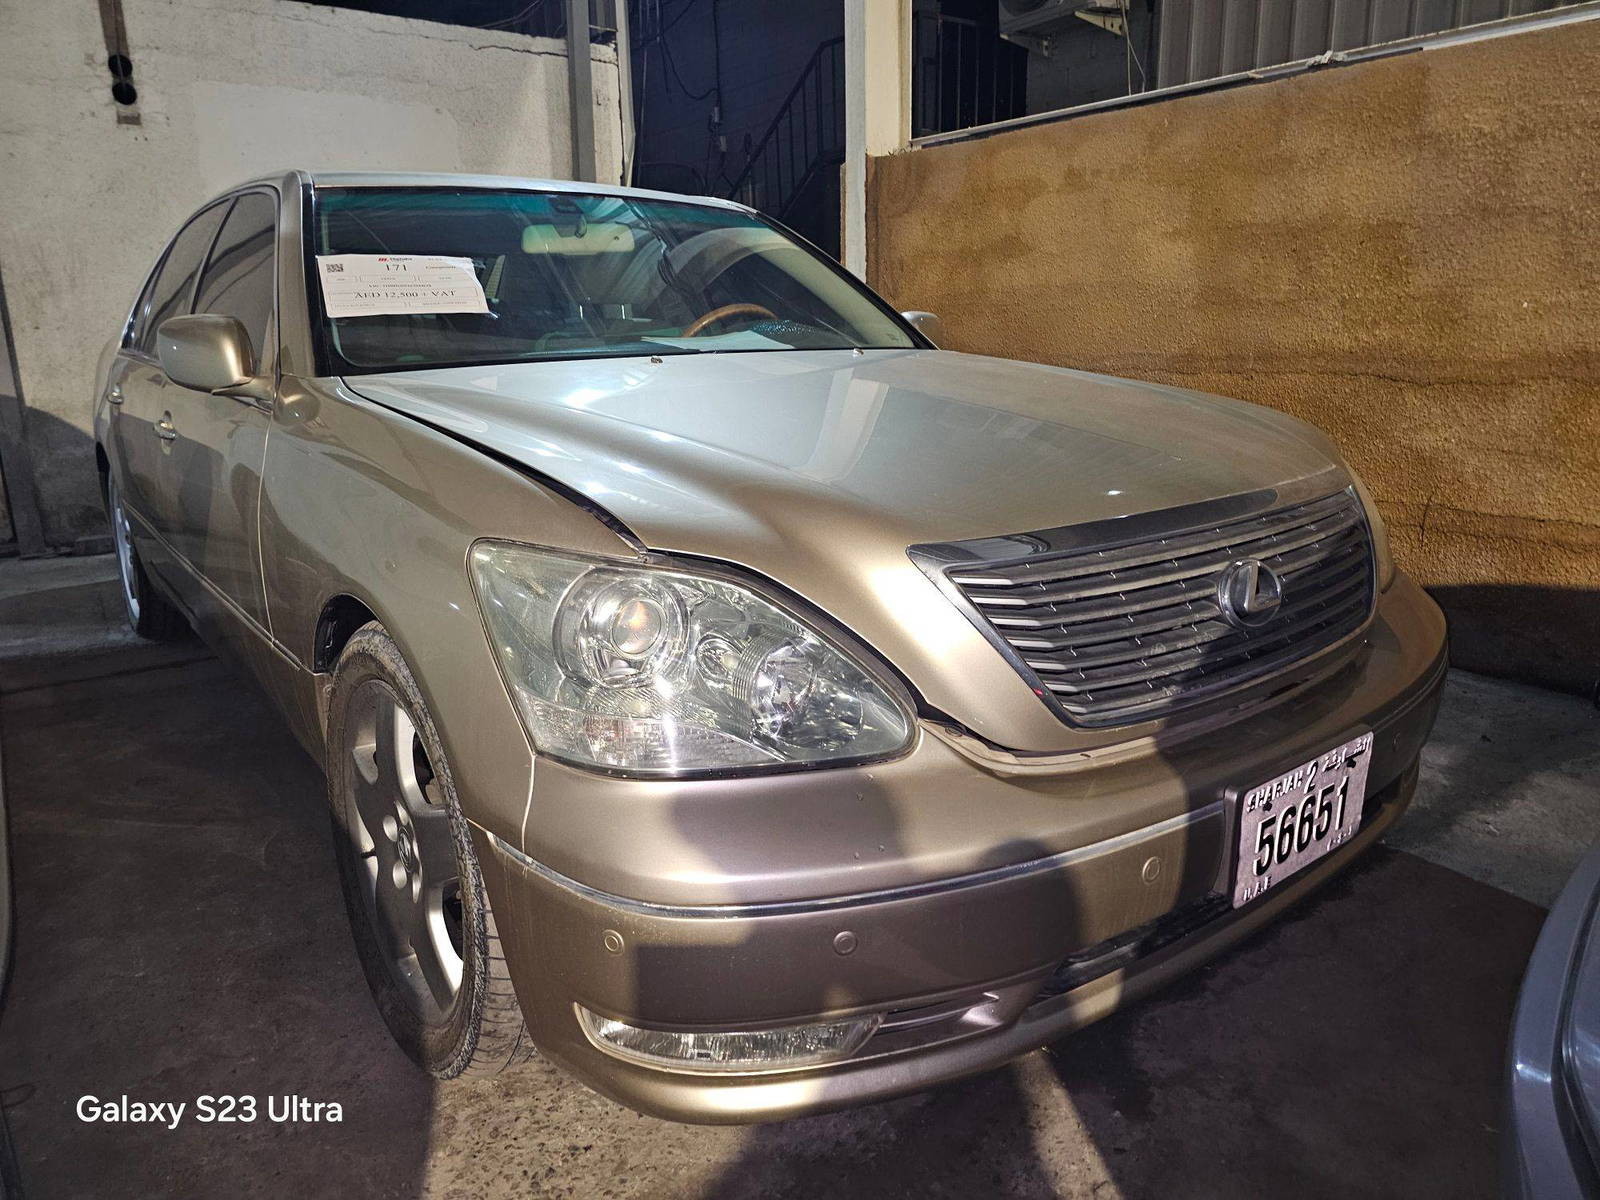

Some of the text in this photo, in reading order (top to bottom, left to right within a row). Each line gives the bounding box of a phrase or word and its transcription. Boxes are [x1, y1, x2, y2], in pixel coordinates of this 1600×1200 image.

[385, 263, 407, 271] 171
[354, 291, 381, 299] AED
[385, 291, 418, 299] 12,500
[431, 289, 457, 297] VAT
[1304, 760, 1319, 793] 2
[1253, 776, 1349, 876] 56651
